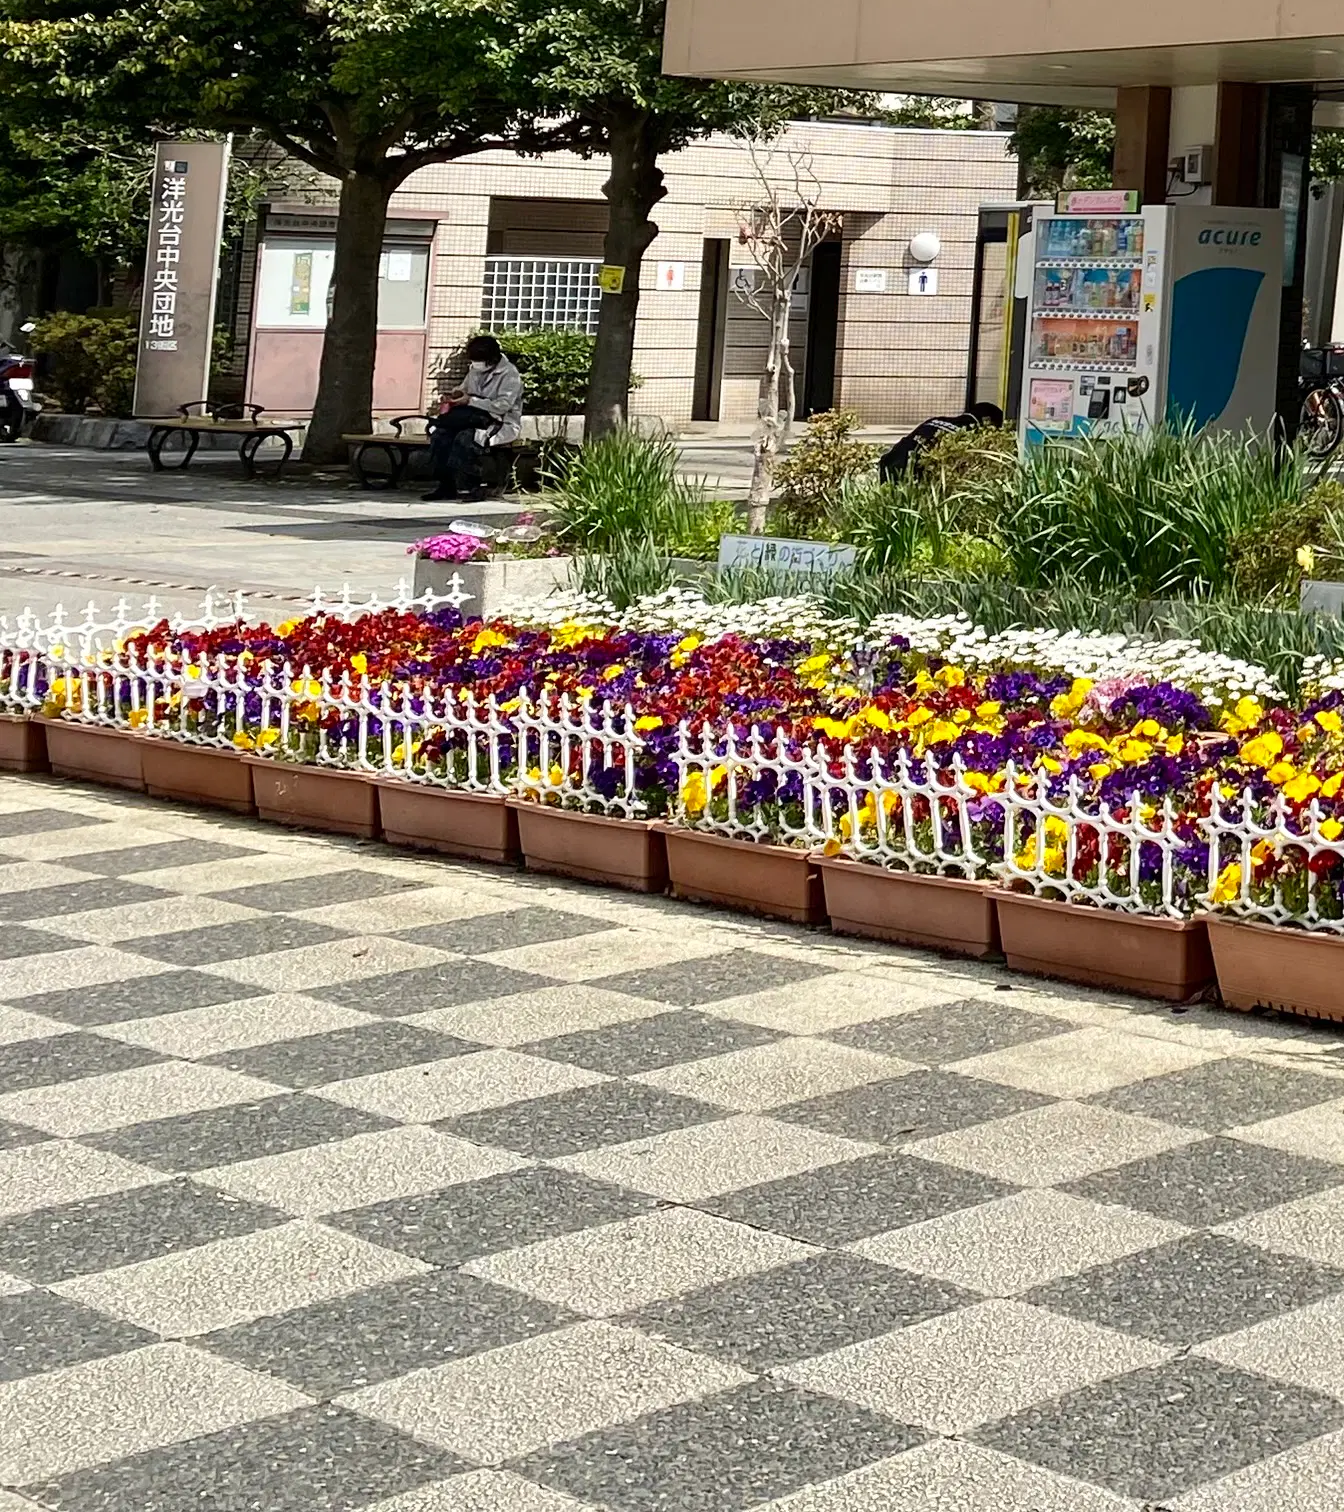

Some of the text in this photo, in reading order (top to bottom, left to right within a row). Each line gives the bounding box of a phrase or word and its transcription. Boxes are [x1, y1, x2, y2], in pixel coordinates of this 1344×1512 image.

[149, 176, 187, 338] 洋光台中央団地
[1197, 228, 1262, 247] acure
